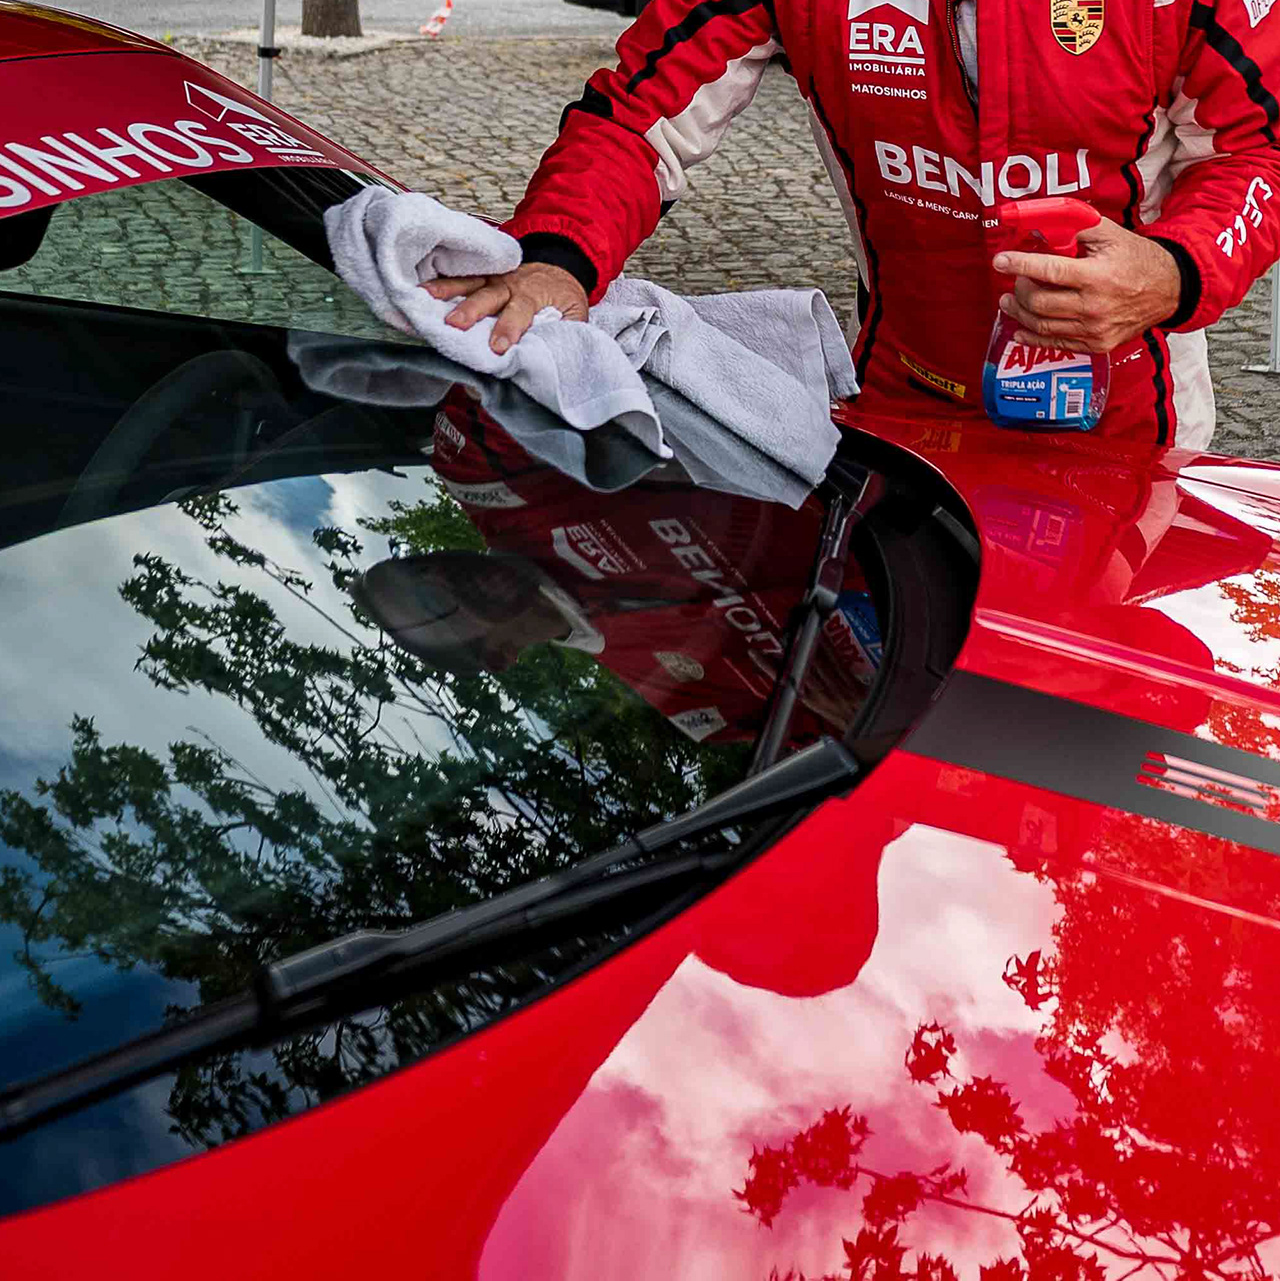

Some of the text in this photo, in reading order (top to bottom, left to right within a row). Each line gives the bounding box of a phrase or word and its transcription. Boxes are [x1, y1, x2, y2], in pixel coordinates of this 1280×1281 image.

[849, 22, 925, 55] ERA
[849, 62, 926, 77] IMOBILIÁRIA
[851, 83, 927, 100] MATOSINHOS
[226, 122, 313, 150] ERA
[875, 140, 1090, 207] BENOLI
[917, 198, 925, 208] &
[1004, 346, 1076, 374] AJAX
[1001, 379, 1046, 391] TRIPLA AÇÃO
